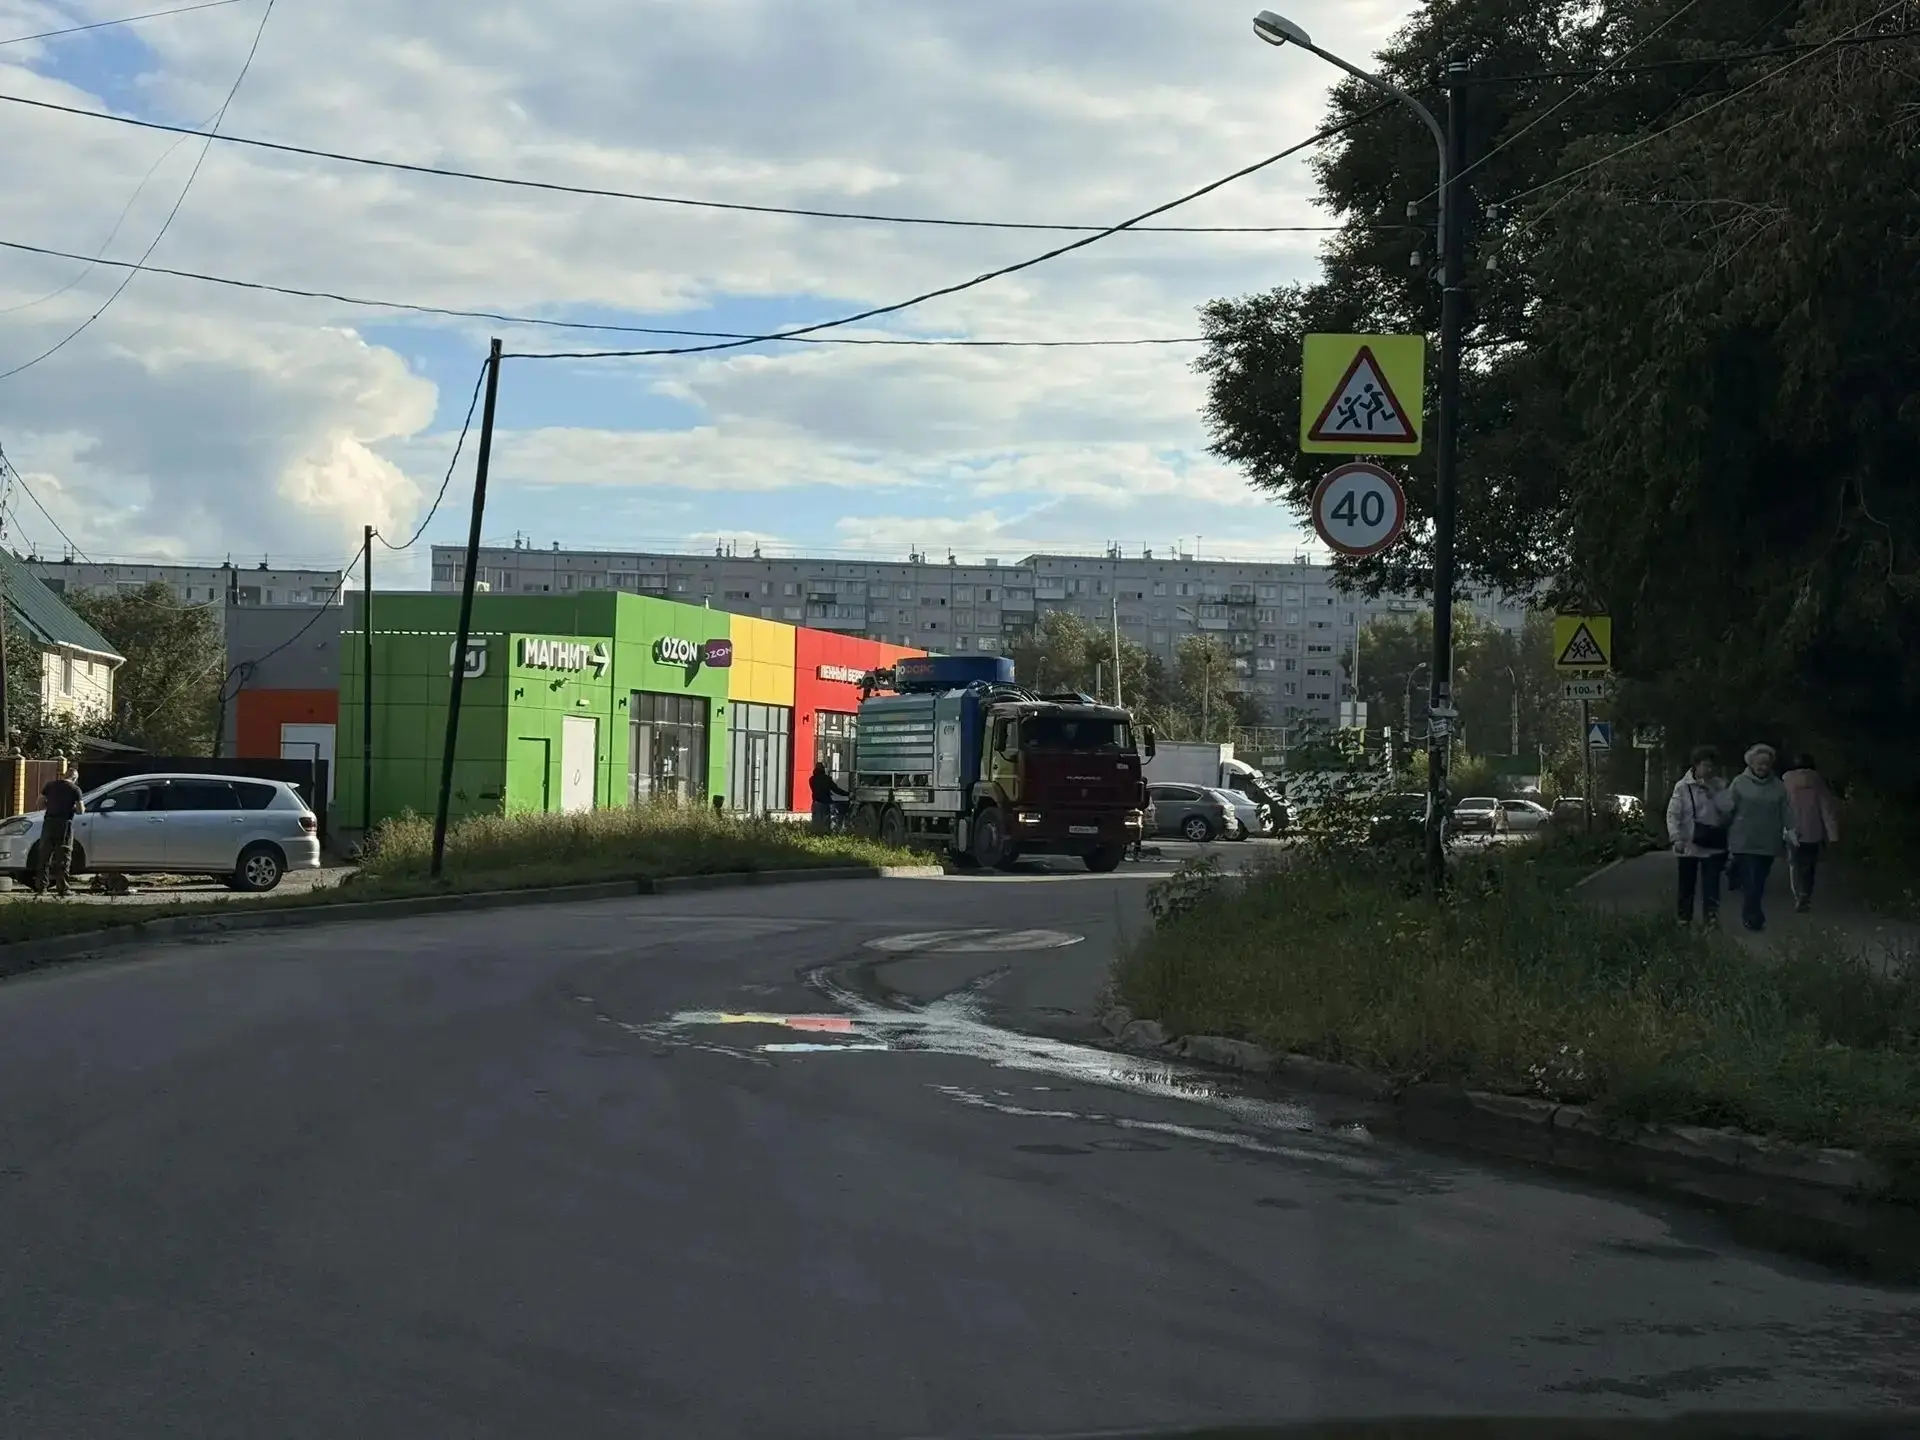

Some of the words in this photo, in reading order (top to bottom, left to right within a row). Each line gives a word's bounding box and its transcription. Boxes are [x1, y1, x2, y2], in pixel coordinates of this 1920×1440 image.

[1330, 490, 1385, 527] 40
[524, 637, 590, 670] МАГНИТ
[662, 636, 698, 662] OZON
